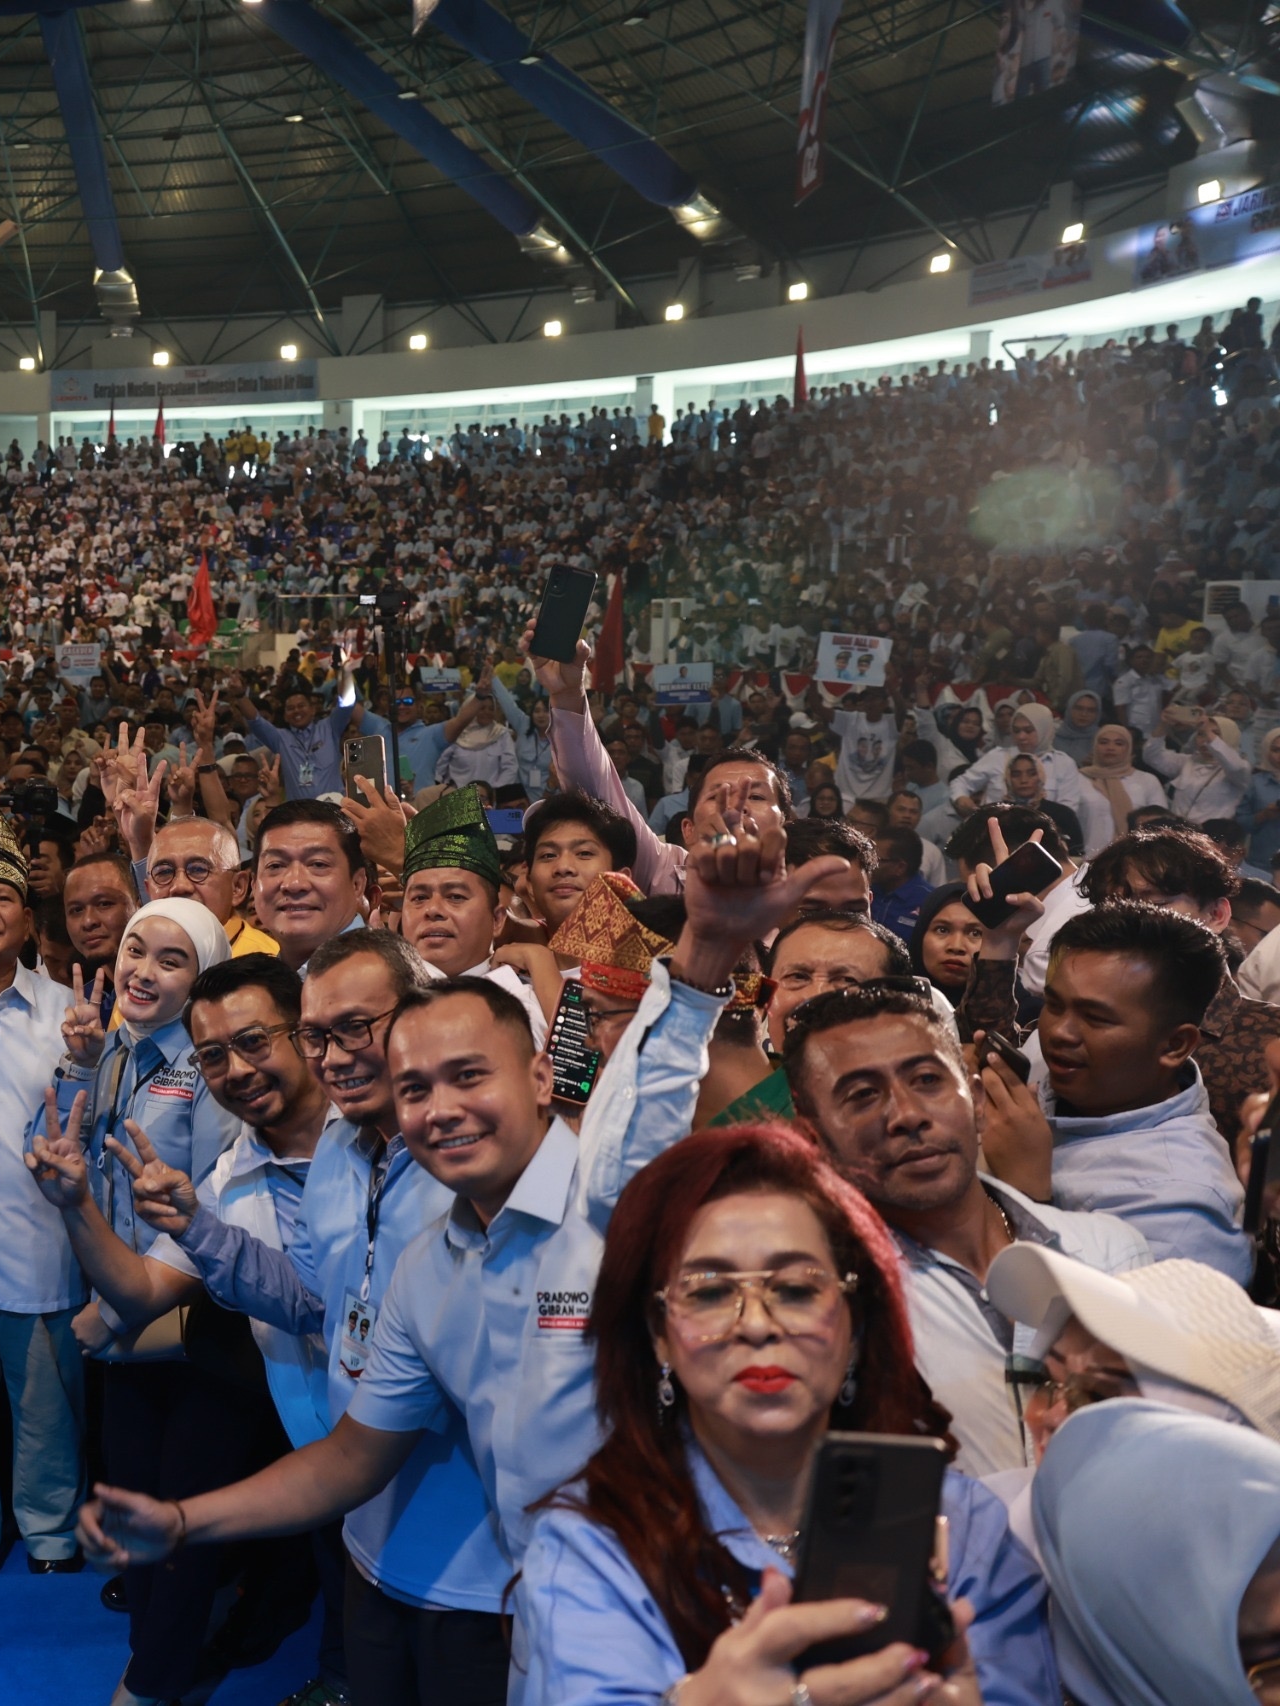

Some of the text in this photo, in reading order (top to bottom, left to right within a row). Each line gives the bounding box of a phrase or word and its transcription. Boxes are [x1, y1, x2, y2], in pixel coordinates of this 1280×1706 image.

[127, 381, 155, 397] Muslim
[152, 1075, 184, 1087] GIBRAN
[537, 1291, 589, 1303] PRABOWO
[538, 1304, 574, 1315] GIBRAN
[350, 1354, 360, 1367] VIP
